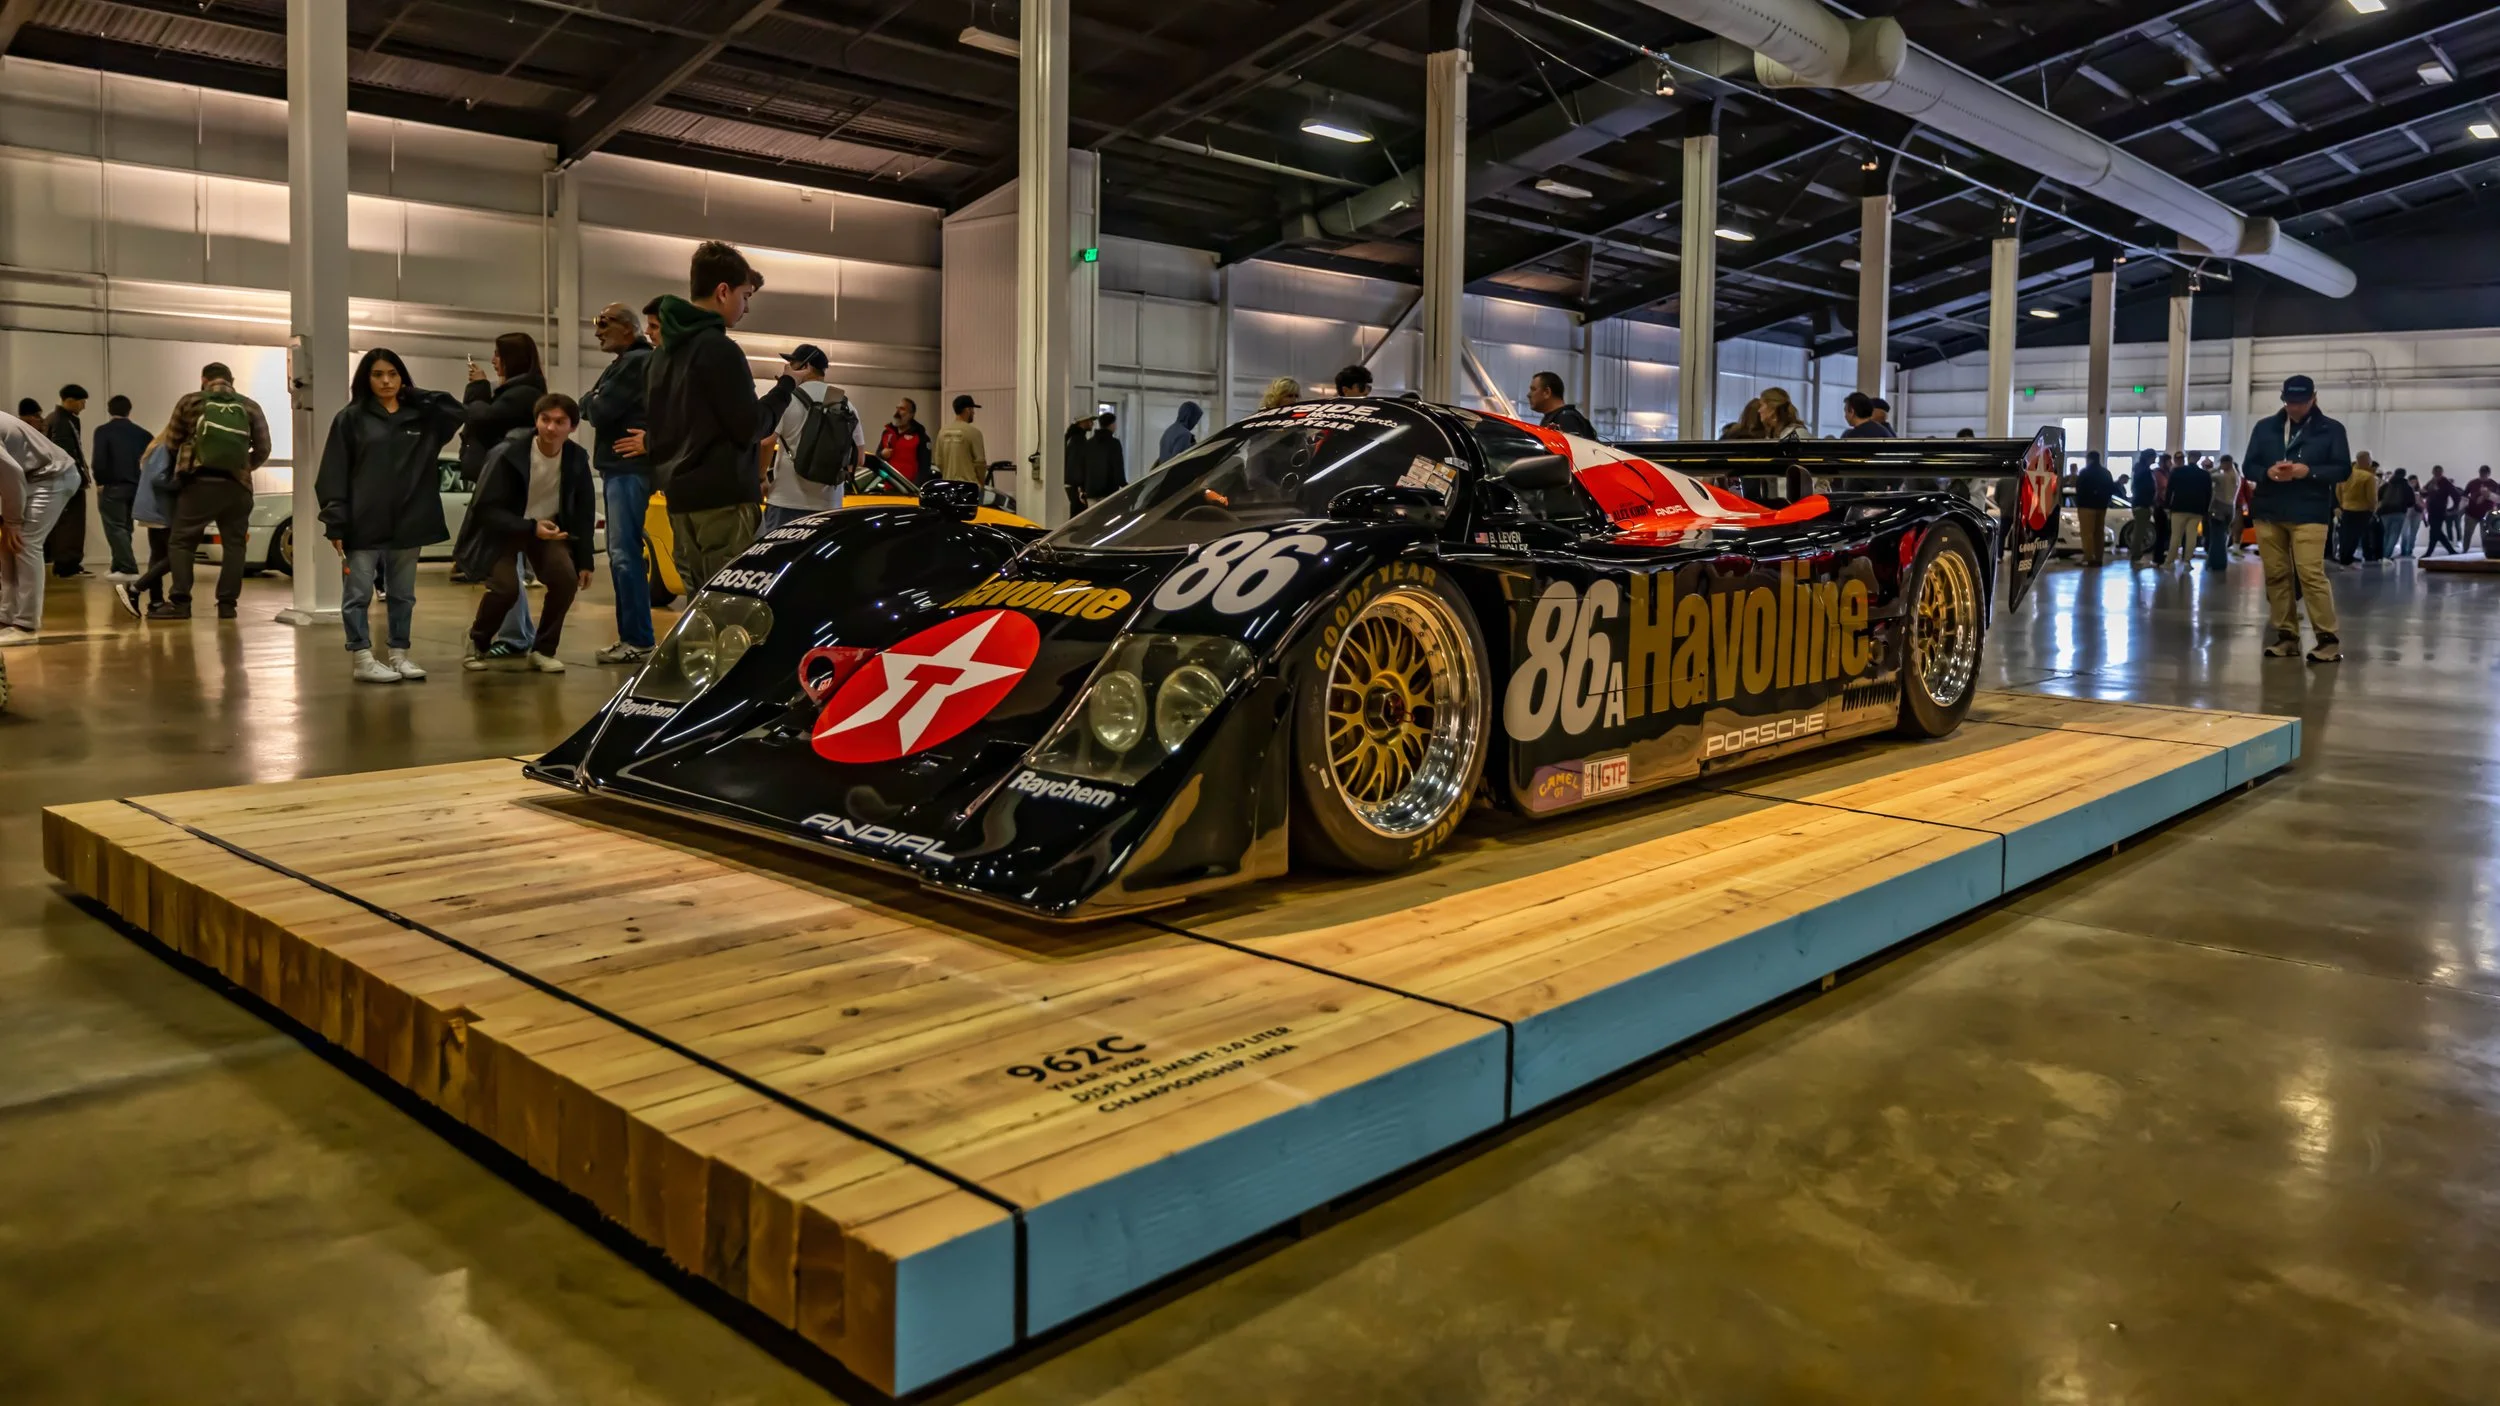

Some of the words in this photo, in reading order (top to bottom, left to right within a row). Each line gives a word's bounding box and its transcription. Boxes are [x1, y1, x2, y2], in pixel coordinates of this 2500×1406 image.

[1242, 417, 1355, 431] GOODYEAR
[1306, 411, 1398, 429] Motorsports
[1655, 505, 1689, 517] ANDIAL
[764, 528, 818, 540] UNION
[1272, 519, 1330, 533] A
[741, 543, 774, 555] AIR
[710, 569, 778, 591] BOSCH
[1153, 531, 1328, 615] 86
[1627, 560, 1868, 719] Havoline
[1503, 579, 1620, 742] 86
[1602, 662, 1626, 728] A
[618, 698, 678, 718] Raychem
[1706, 713, 1824, 756] PORSCHE
[1538, 773, 1579, 797] CAMEL
[1601, 761, 1627, 787] GTP
[1007, 770, 1117, 809] Raychem
[801, 813, 955, 863] ANDIAL
[1243, 1027, 1293, 1045] LITER
[1006, 1036, 1147, 1082] 962C
[1249, 1047, 1299, 1062] IMSA
